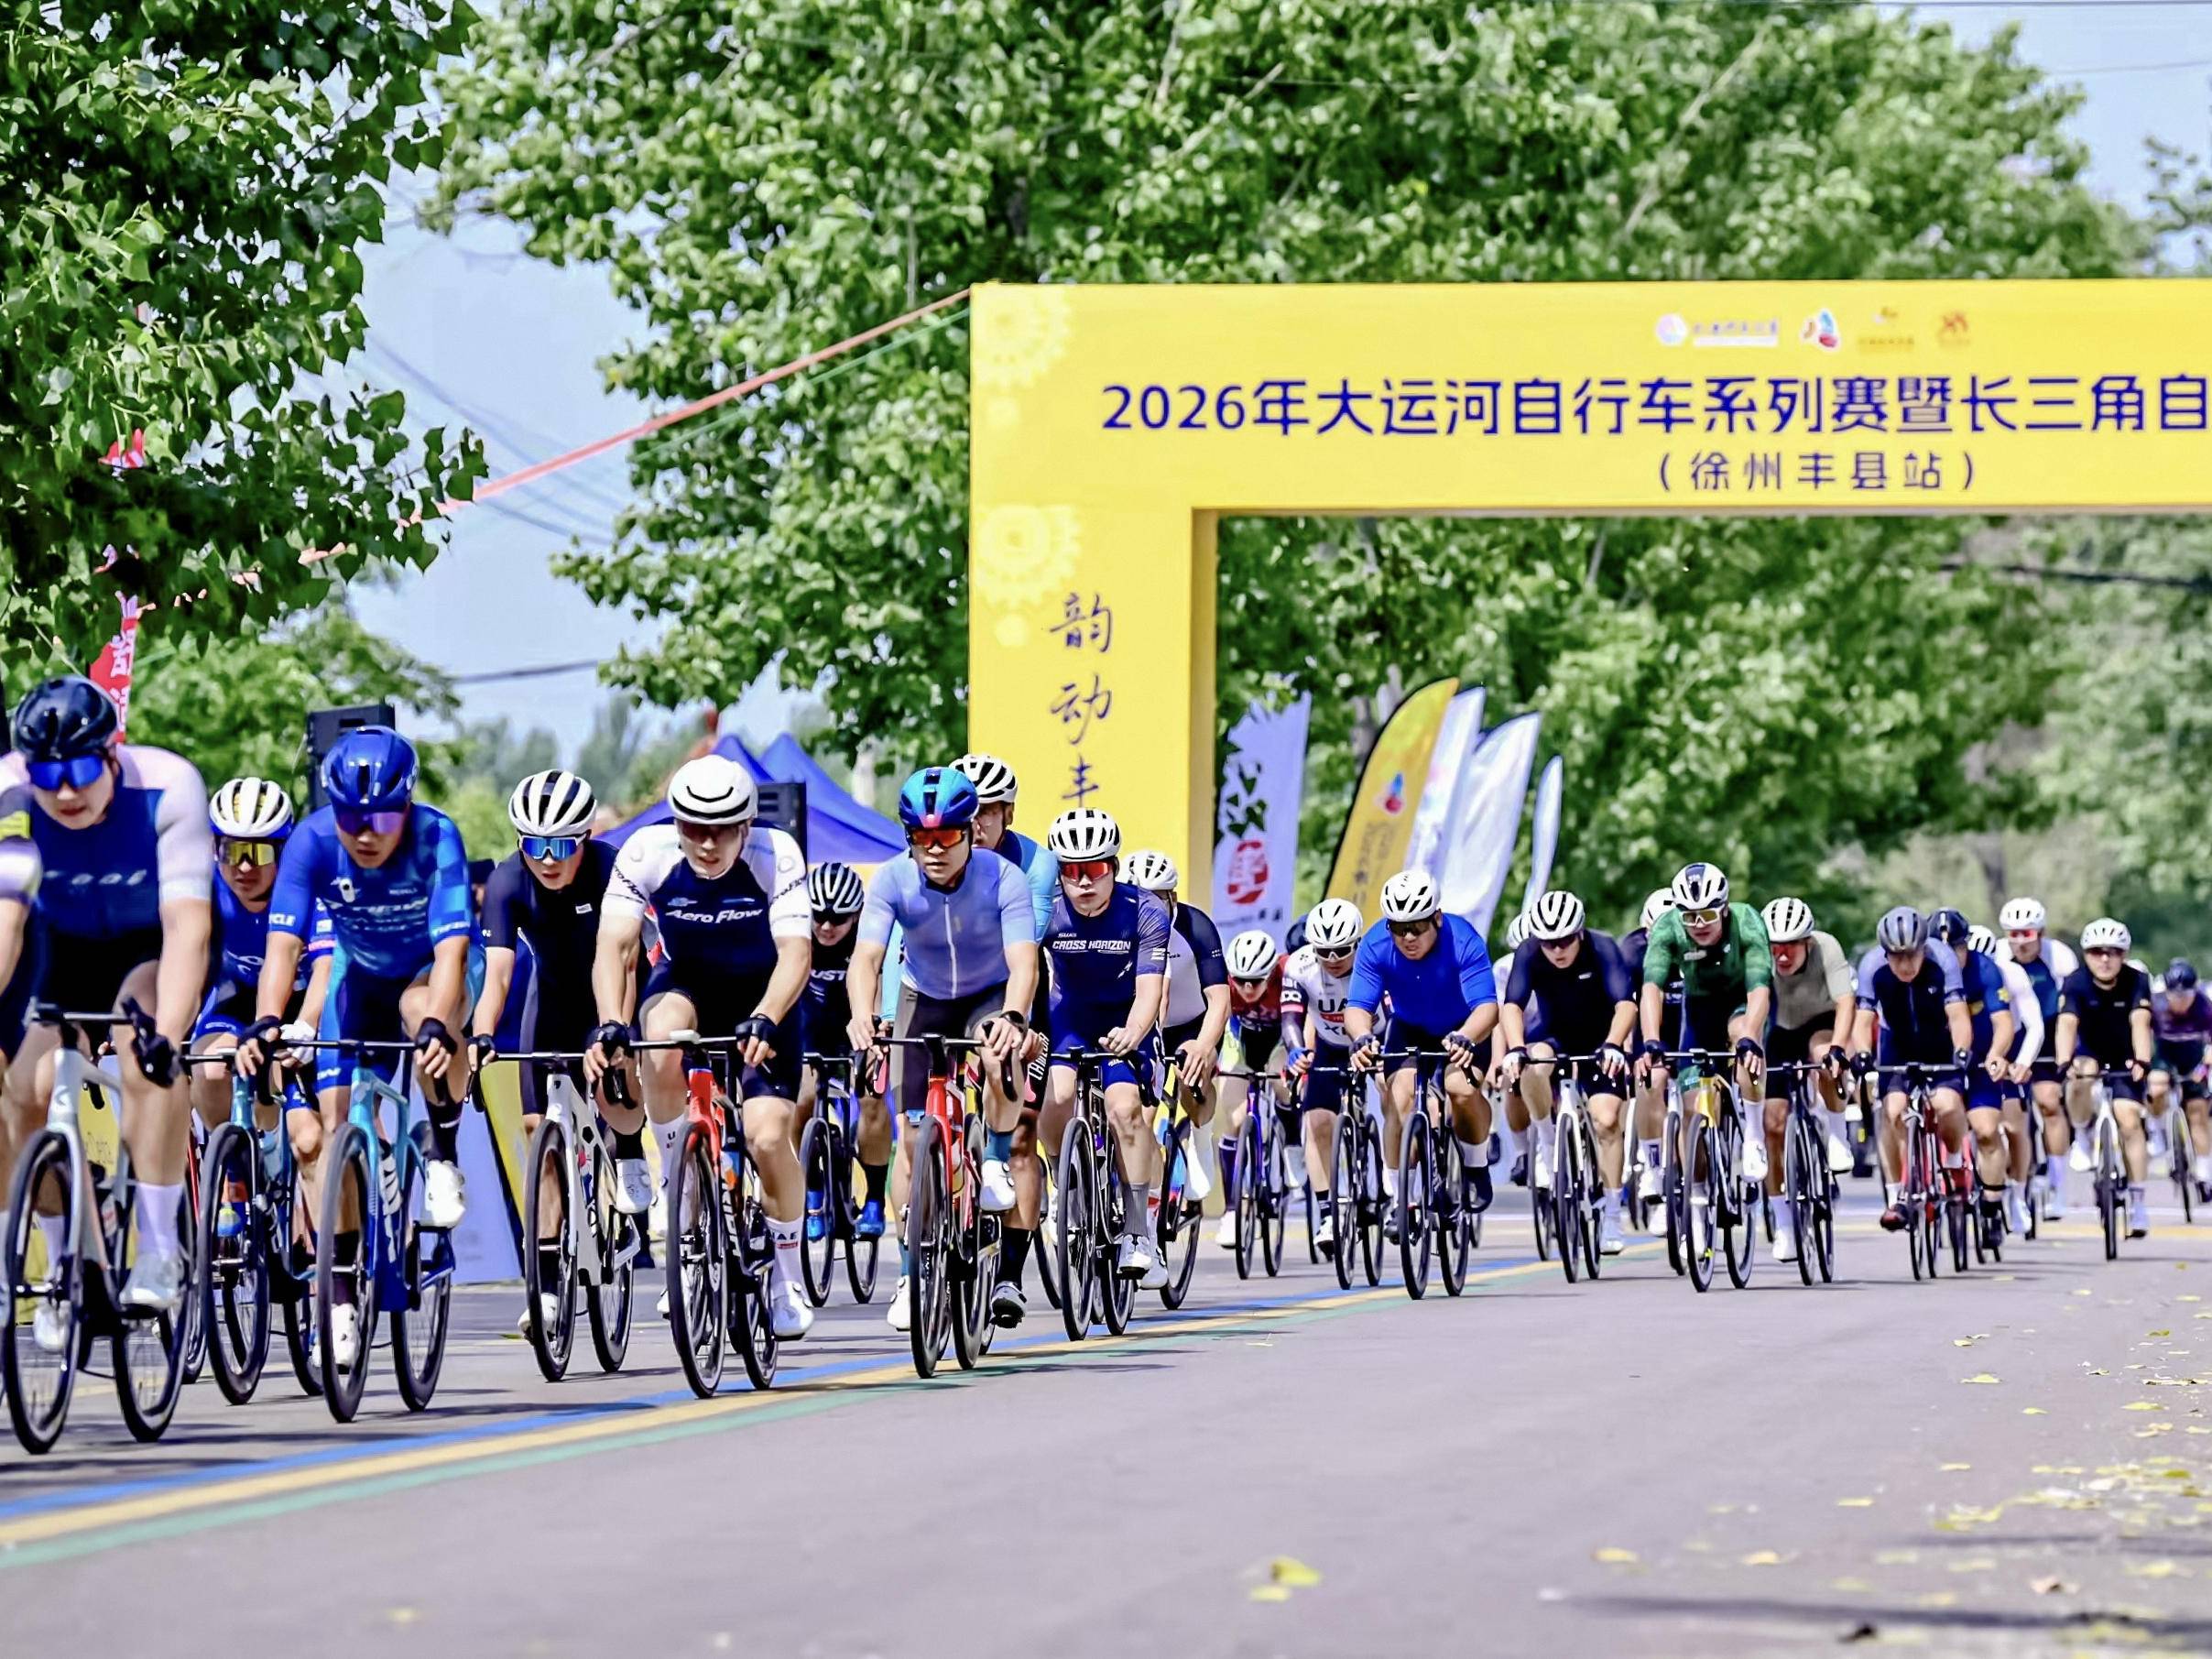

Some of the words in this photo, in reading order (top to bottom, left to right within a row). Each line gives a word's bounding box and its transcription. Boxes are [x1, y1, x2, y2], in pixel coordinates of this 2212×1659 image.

[1102, 373, 2208, 435] 2026年大运河自行车系列赛暨长三角自
[665, 909, 714, 923] Aero
[714, 908, 764, 924] Flow
[1052, 939, 1087, 951] CROSS
[1087, 939, 1131, 952] HORIZON
[810, 968, 847, 982] UST
